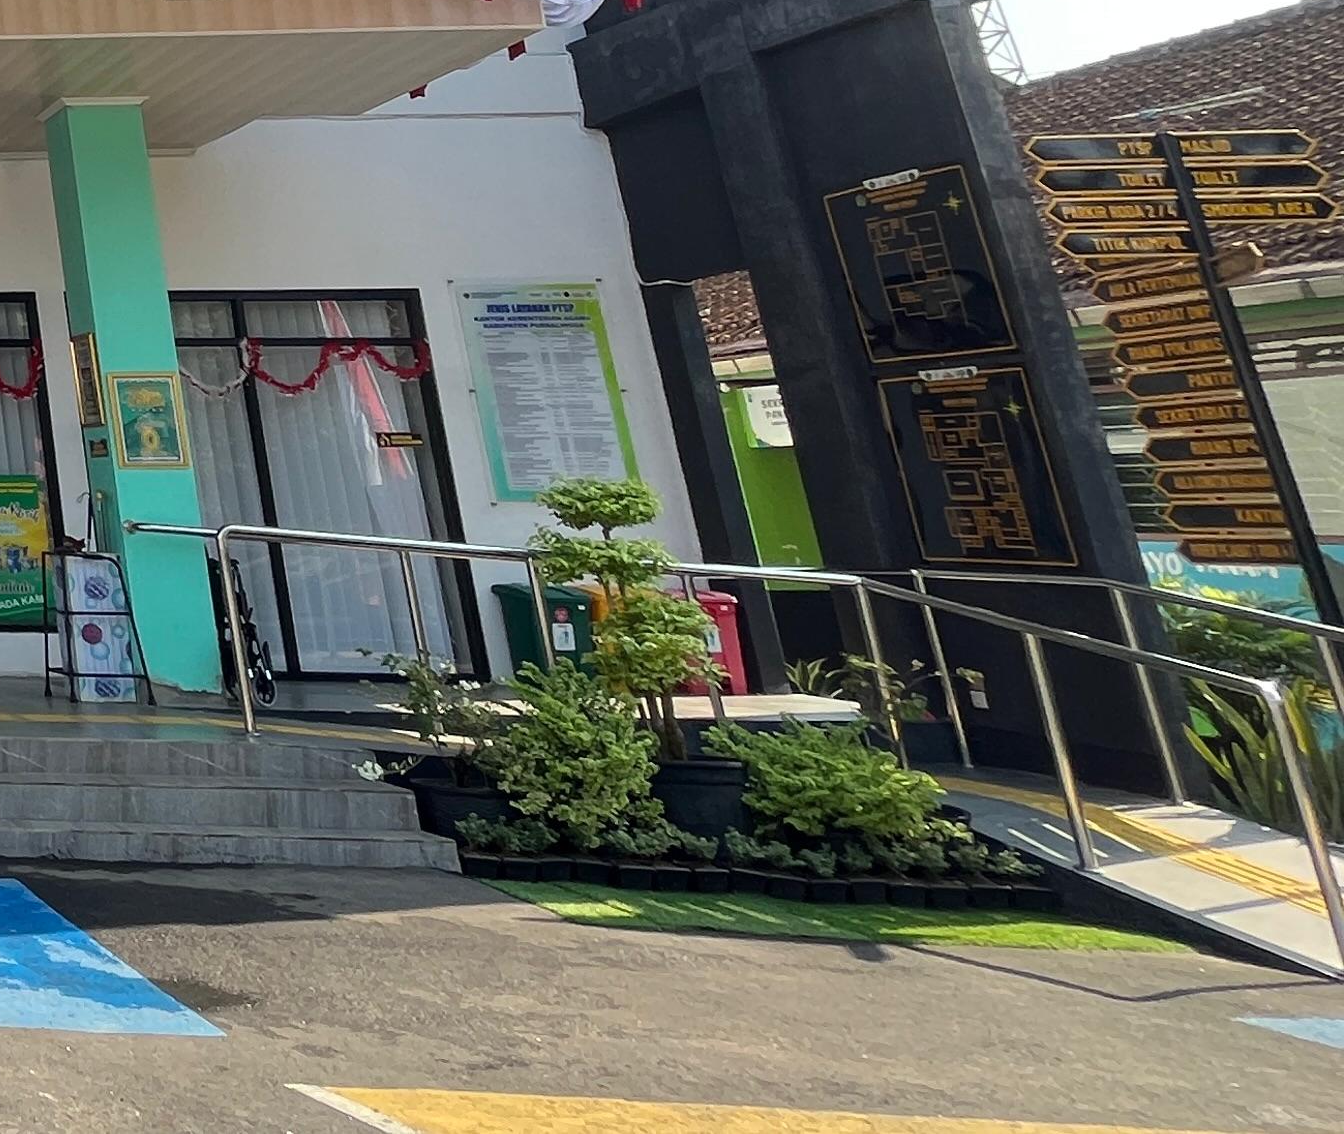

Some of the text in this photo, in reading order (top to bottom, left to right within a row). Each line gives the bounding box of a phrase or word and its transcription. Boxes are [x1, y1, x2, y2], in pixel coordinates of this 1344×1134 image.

[1118, 142, 1153, 157] PTSP
[1180, 140, 1232, 154] MASJID
[1119, 172, 1164, 187] TOILET
[1191, 171, 1240, 186] TOILET
[1062, 206, 1107, 220] PARKIR
[1276, 202, 1317, 216] AREA
[1093, 237, 1130, 252] TITIK
